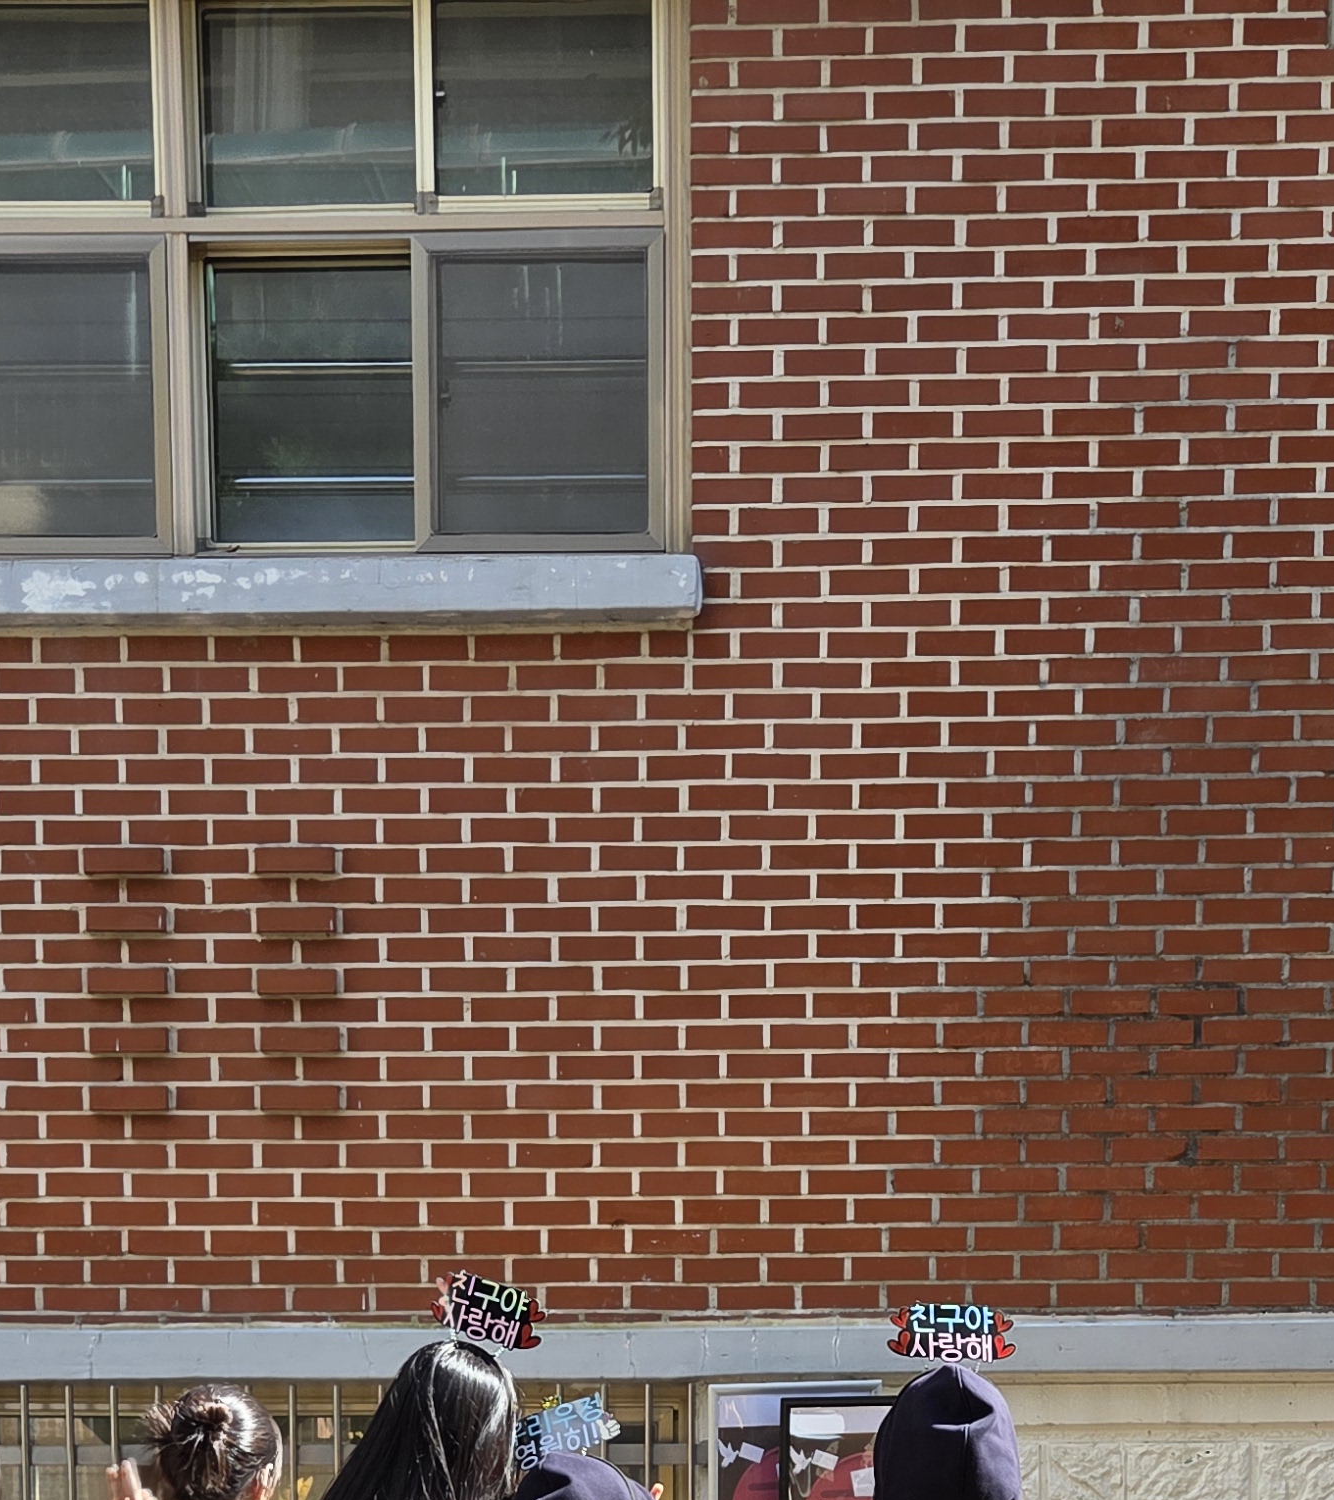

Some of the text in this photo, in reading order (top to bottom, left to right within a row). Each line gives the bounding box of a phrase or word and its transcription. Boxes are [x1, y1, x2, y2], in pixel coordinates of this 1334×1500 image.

[452, 1269, 530, 1320] 친구야
[443, 1302, 520, 1351] 사랑해
[909, 1301, 994, 1334] 친구야
[909, 1332, 993, 1363] 사랑해
